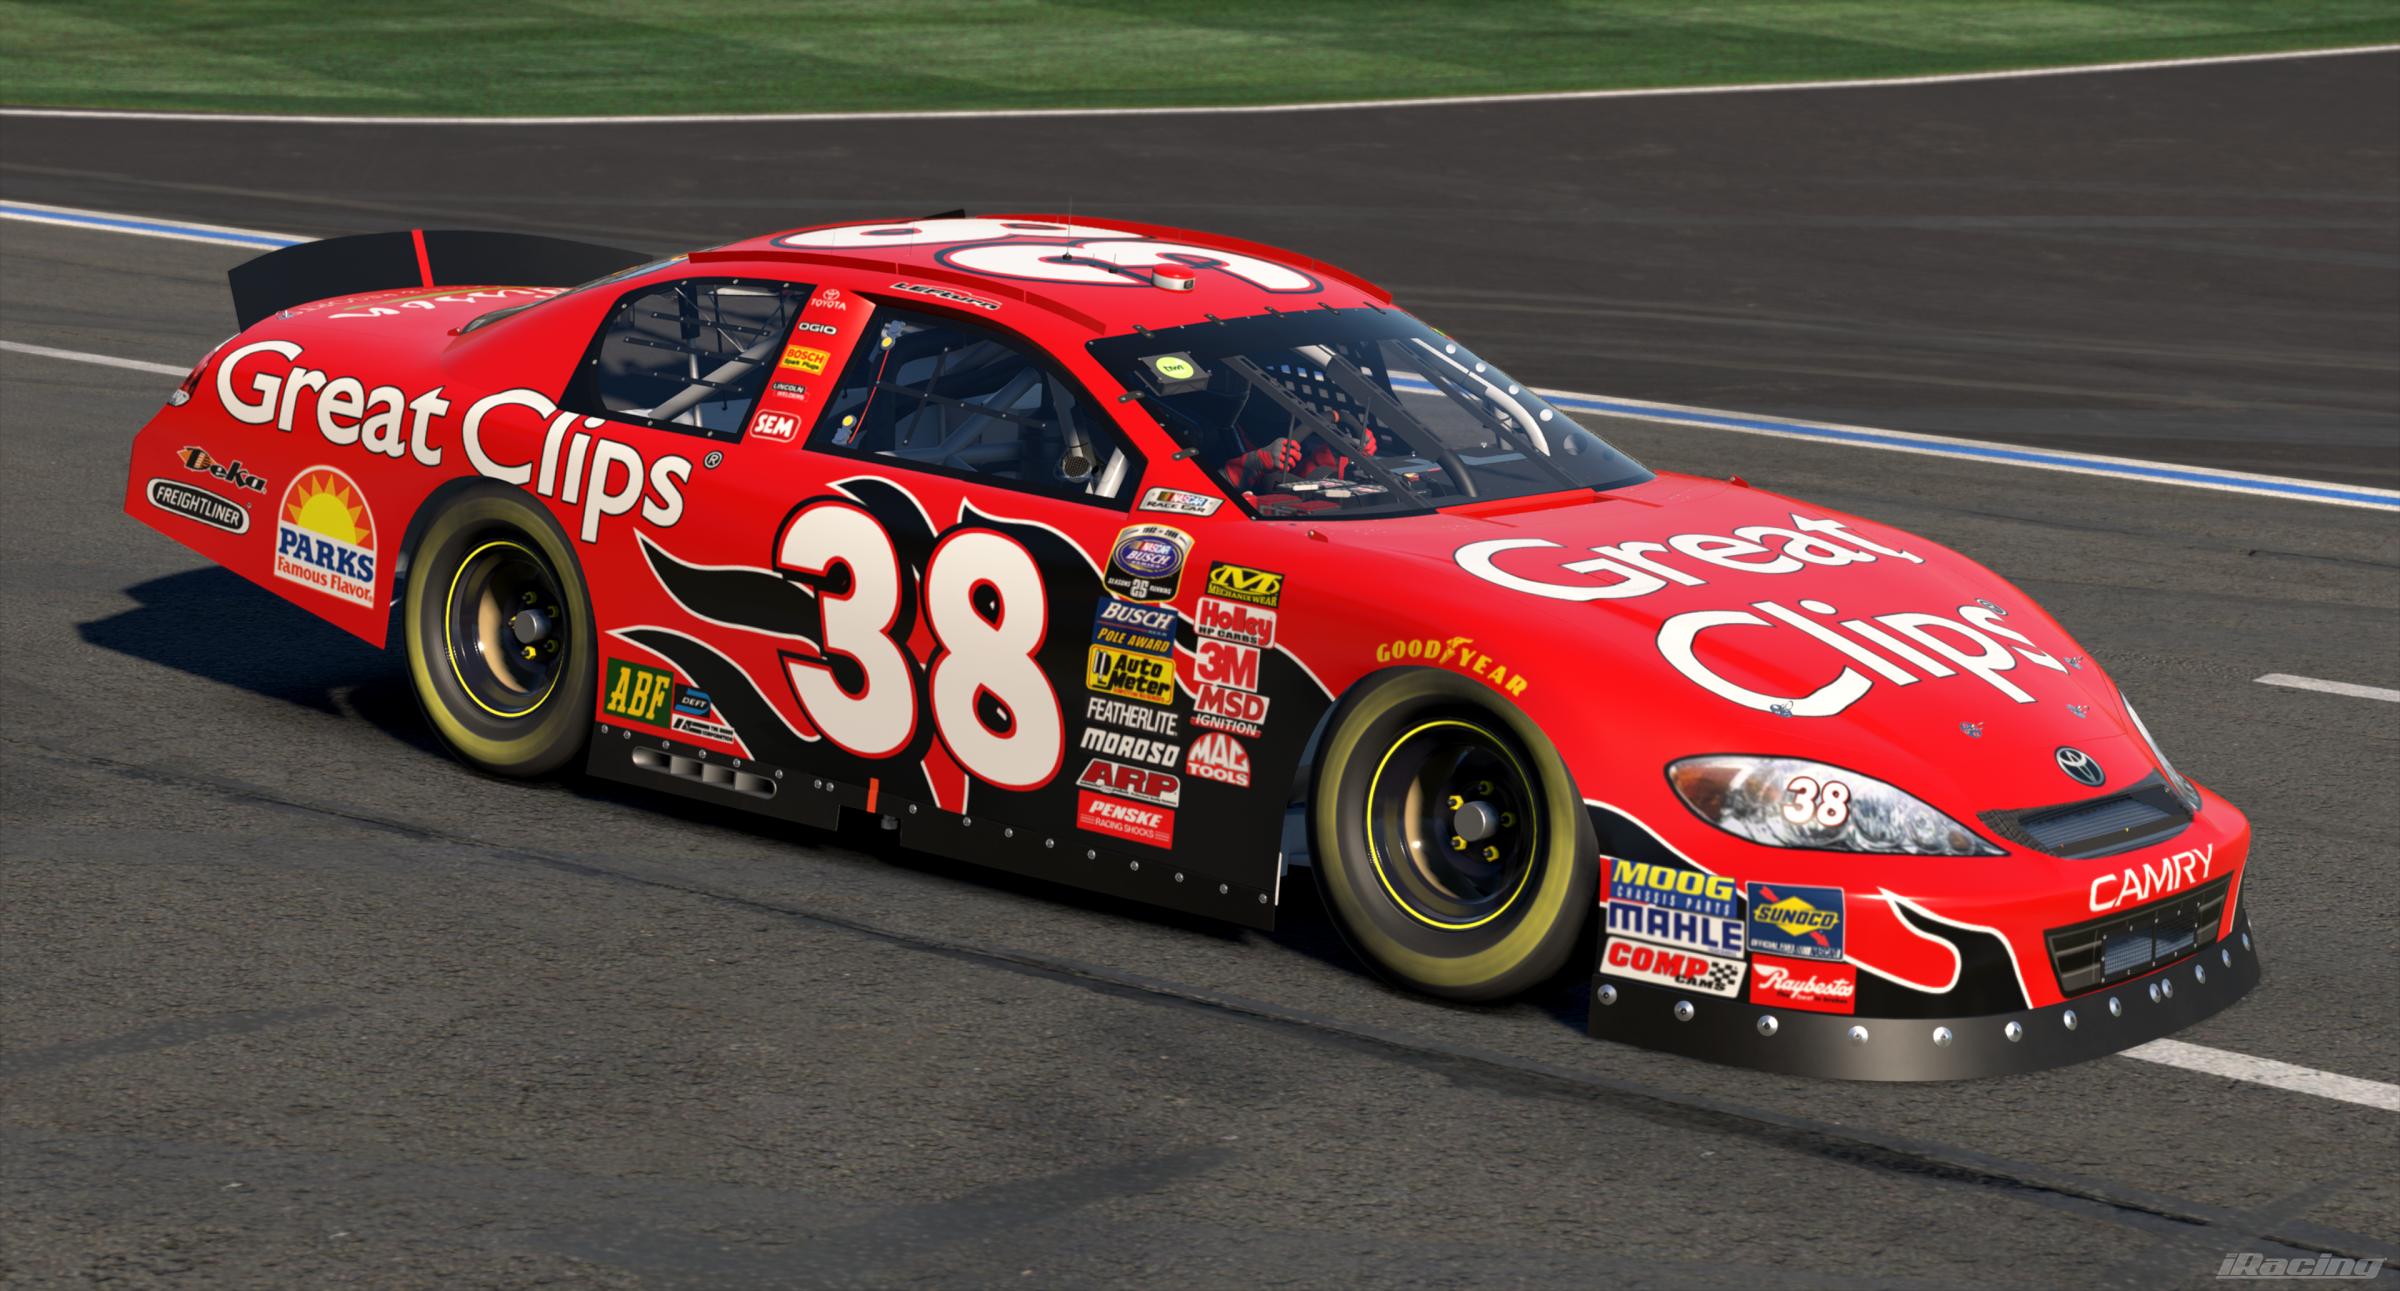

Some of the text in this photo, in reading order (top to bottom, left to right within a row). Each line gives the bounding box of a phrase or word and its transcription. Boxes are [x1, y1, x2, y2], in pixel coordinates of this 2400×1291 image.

[768, 216, 1325, 295] 38
[810, 298, 847, 311] TOYOTA
[798, 322, 837, 335] OGIO
[783, 358, 801, 367] Spark
[786, 349, 825, 364] BOSCH
[773, 383, 804, 394] LINCOLN
[754, 413, 794, 438] SEM
[216, 340, 693, 544] Great Clips
[177, 446, 267, 494] Deka
[155, 486, 241, 526] FREIGHTLINER
[1146, 500, 1206, 513] RACE CAR
[278, 527, 374, 583] PARKS
[1126, 550, 1171, 566] BUSCH
[1141, 541, 1172, 555] NASCAR
[1453, 513, 1926, 602] Great
[277, 556, 328, 587] Famous
[1130, 579, 1149, 599] 25
[1207, 583, 1278, 607] MECHANIX WEAR
[1101, 601, 1175, 630] BUSCH
[1199, 600, 1273, 647] Holley
[775, 495, 1066, 792] 38
[1097, 627, 1127, 644] POLE
[1127, 634, 1171, 653] AWARD
[1198, 626, 1258, 644] HP CARBS
[1114, 654, 1163, 679] Auto
[1197, 641, 1258, 690] 3M
[1376, 636, 1529, 697] GOODYEAR
[1656, 599, 2070, 718] Clips
[606, 666, 671, 721] ABF
[1108, 669, 1171, 697] Meter
[681, 696, 708, 709] DEFT
[1087, 697, 1178, 736] FEATHERLITE
[1197, 684, 1265, 722] MSD
[1195, 712, 1258, 737] IGNITION
[1080, 727, 1181, 768] MOROSO
[1188, 733, 1250, 772] MAC
[1080, 760, 1179, 798] ARP
[1188, 762, 1250, 788] TOOLS
[1088, 800, 1163, 828] PENSKE
[1782, 776, 1852, 827] 38
[1095, 818, 1154, 838] RACING SHOCKS
[1613, 859, 1735, 901] MOOG
[2089, 843, 2213, 912] CAMRY
[1617, 884, 1730, 916] CHASSIS PARTS
[1608, 901, 1743, 952] MAHLE
[1758, 905, 1836, 928] SUNOCO
[1608, 941, 1710, 980] COMP
[1674, 975, 1726, 991] CAMS
[1753, 963, 1855, 999] Raybestos
